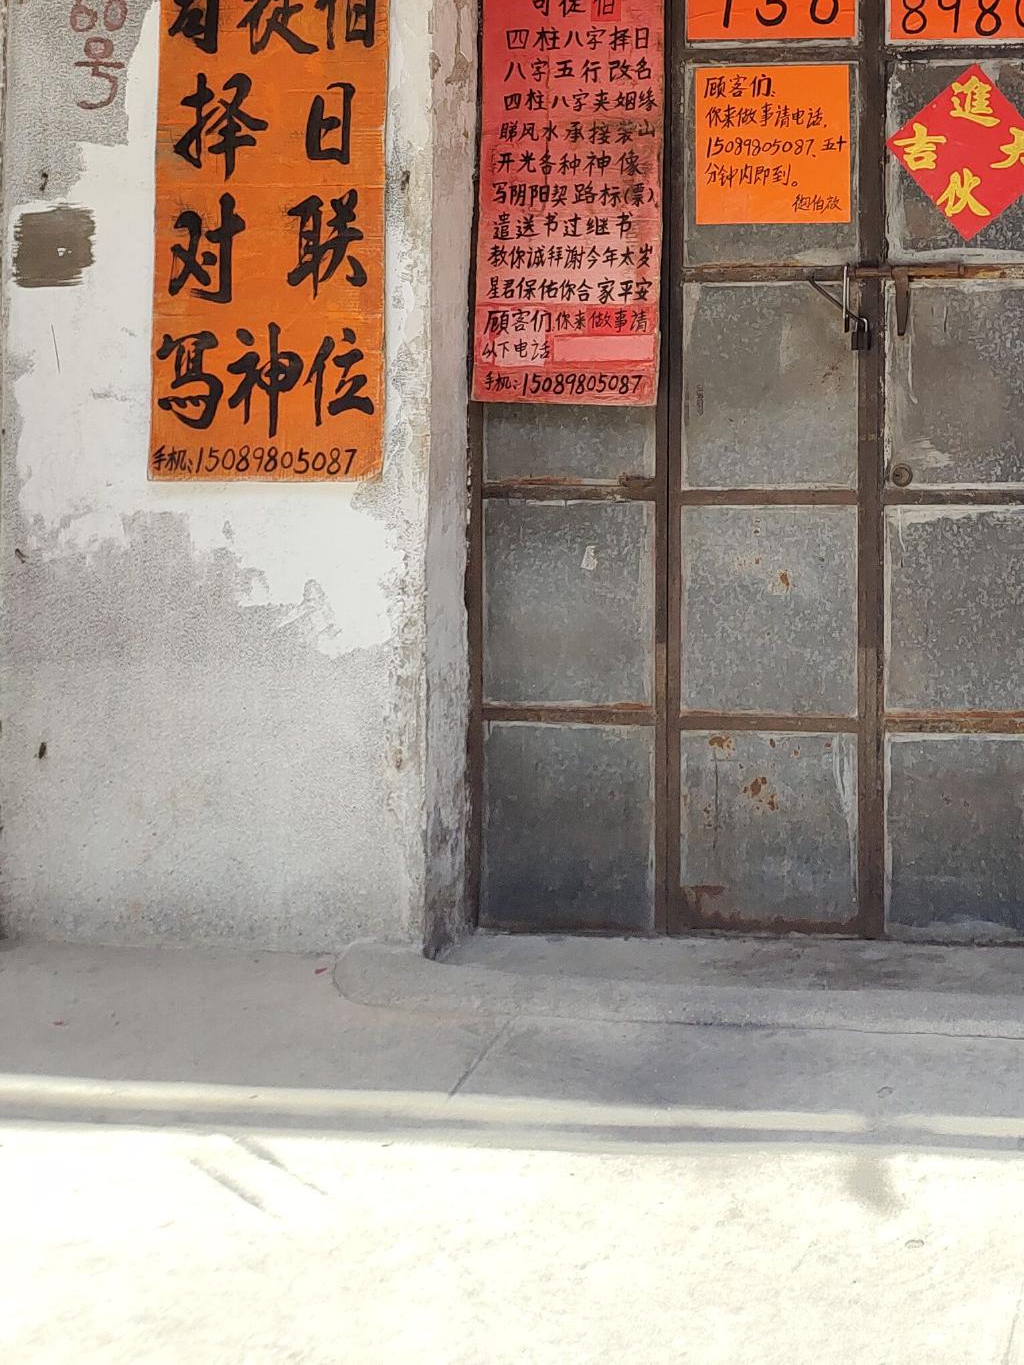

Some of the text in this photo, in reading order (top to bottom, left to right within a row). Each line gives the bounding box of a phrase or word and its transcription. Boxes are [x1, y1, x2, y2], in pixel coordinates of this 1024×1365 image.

[506, 26, 650, 52] 四柱八字择日
[503, 56, 652, 83] 八字五行改名
[172, 72, 356, 181] 择日
[168, 188, 368, 304] 对联
[486, 275, 653, 304] 星君保佑你合家平安
[482, 338, 551, 361] 以下电话
